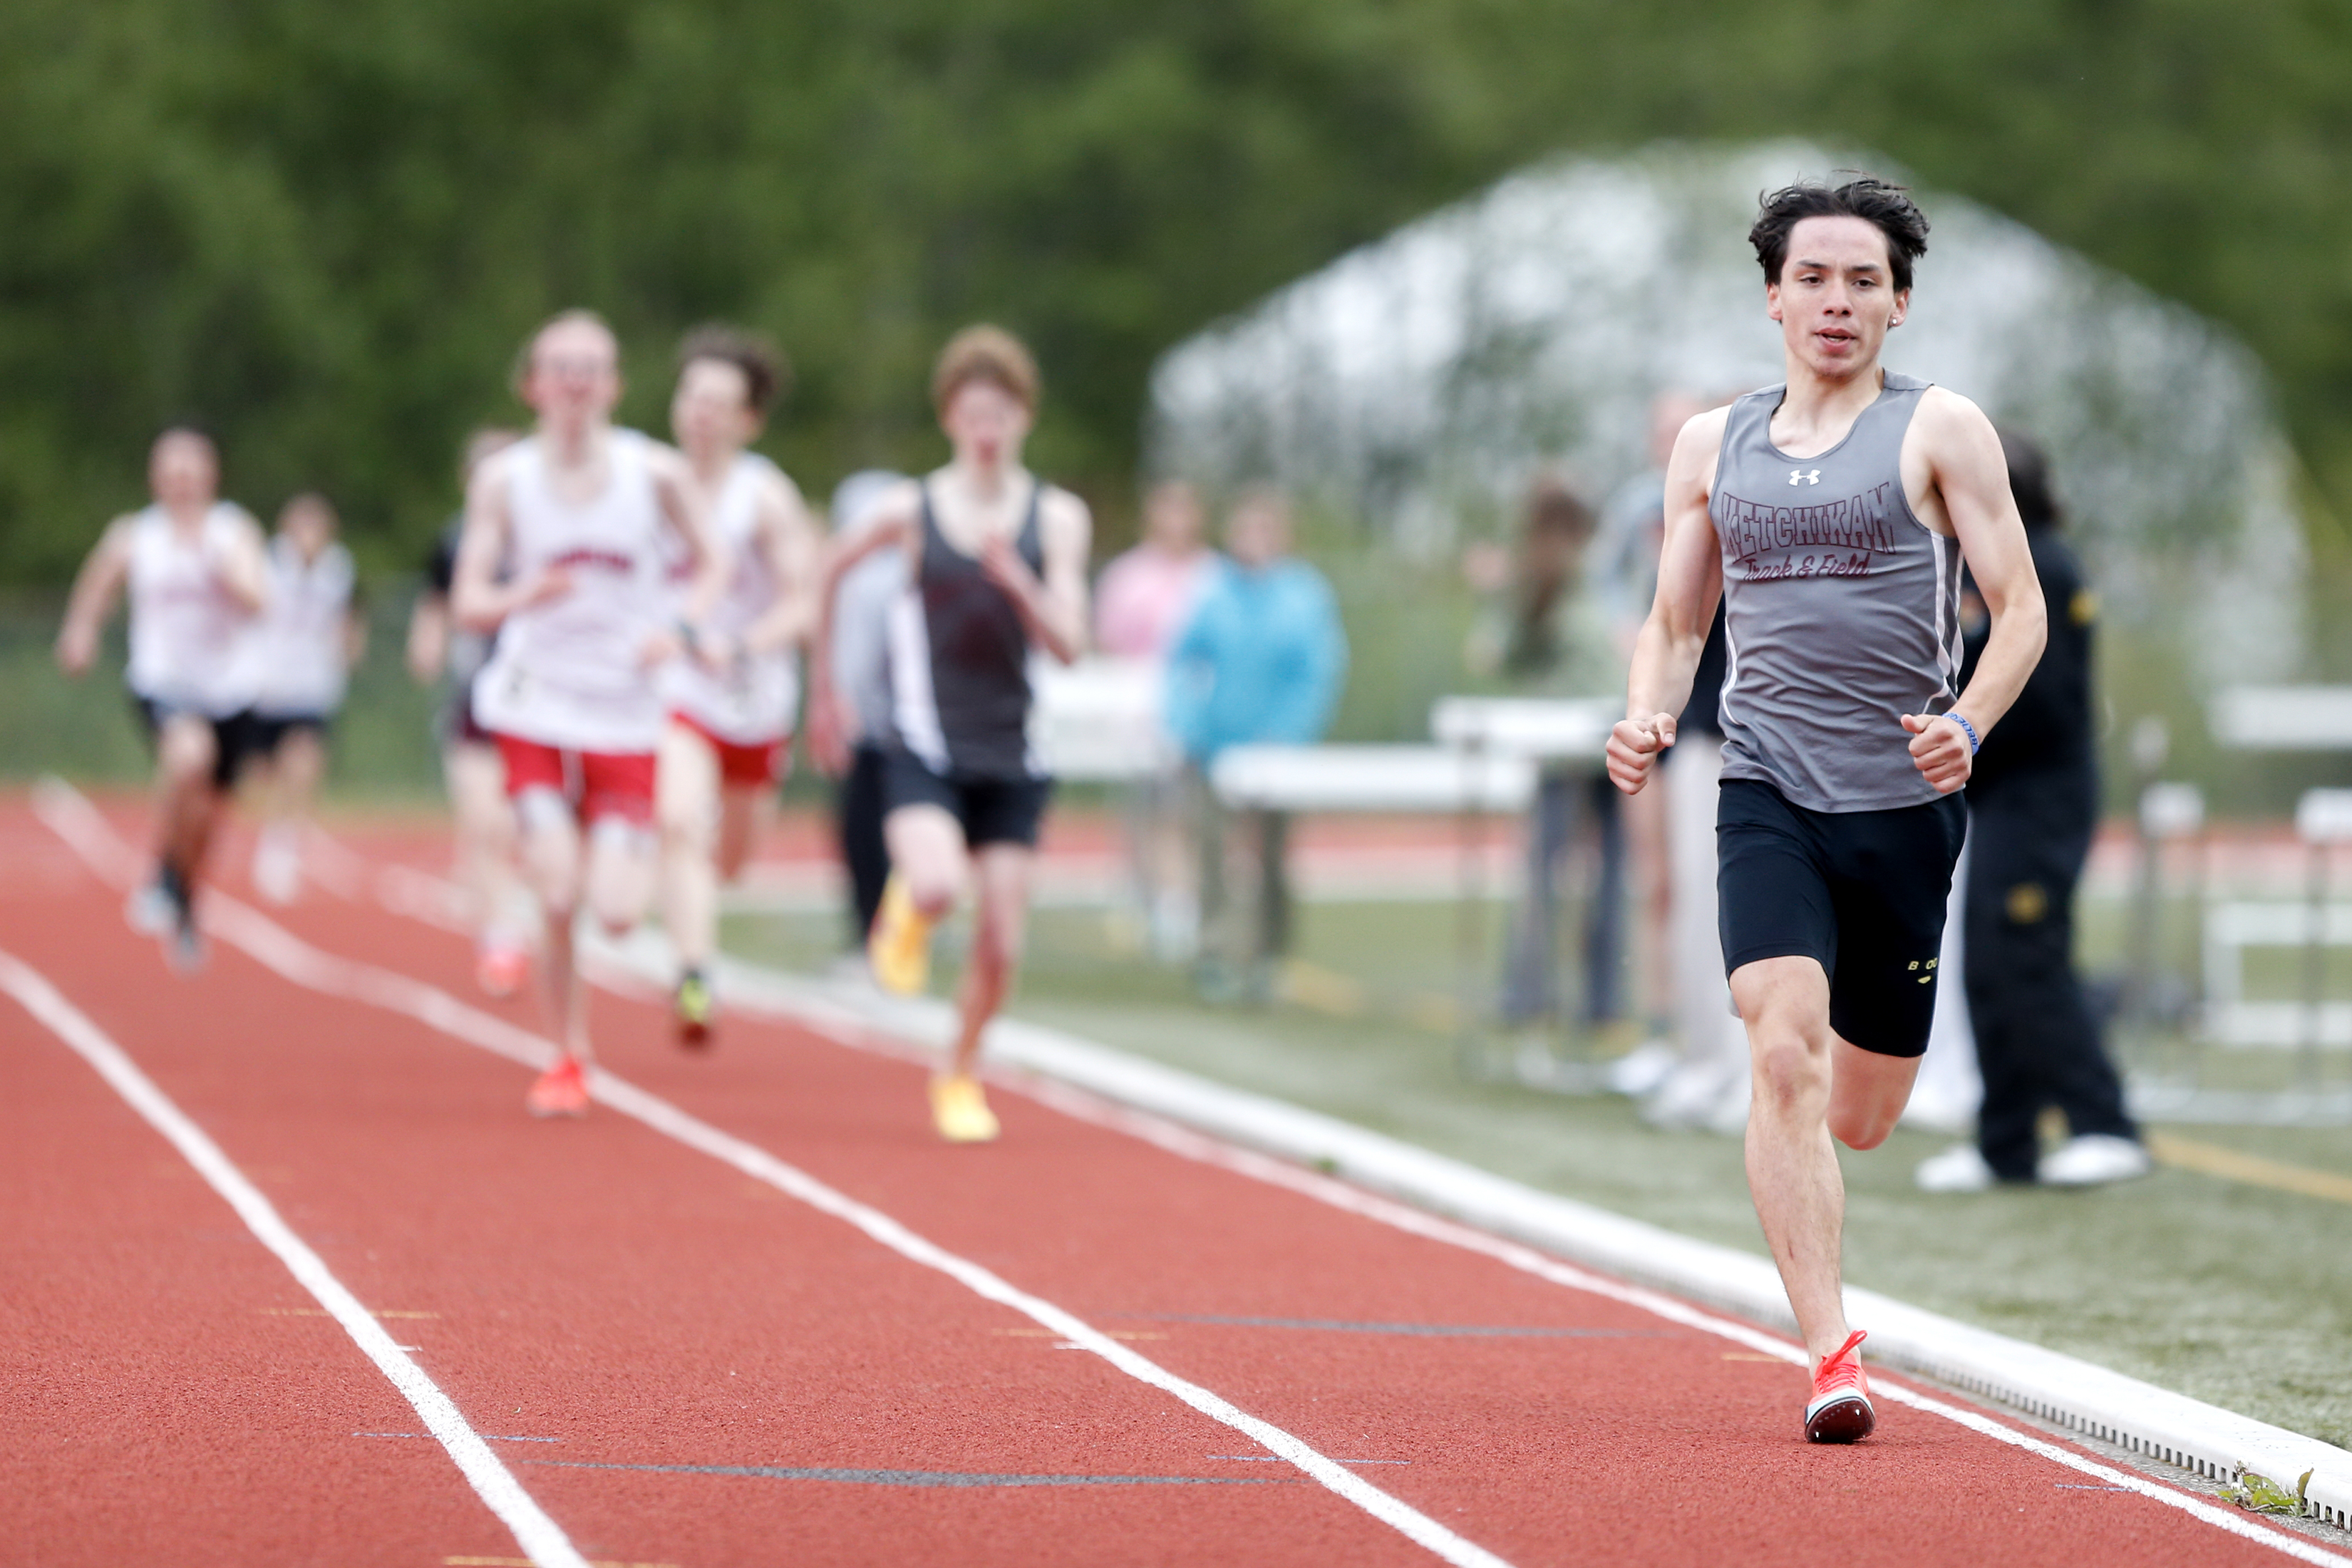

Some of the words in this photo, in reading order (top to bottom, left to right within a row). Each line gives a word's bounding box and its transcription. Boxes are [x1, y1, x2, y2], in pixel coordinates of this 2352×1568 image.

[1721, 482, 1897, 564] KETCHIKAN
[1743, 555, 1793, 582] Track
[1796, 555, 1815, 578] &
[1817, 552, 1871, 577] Field
